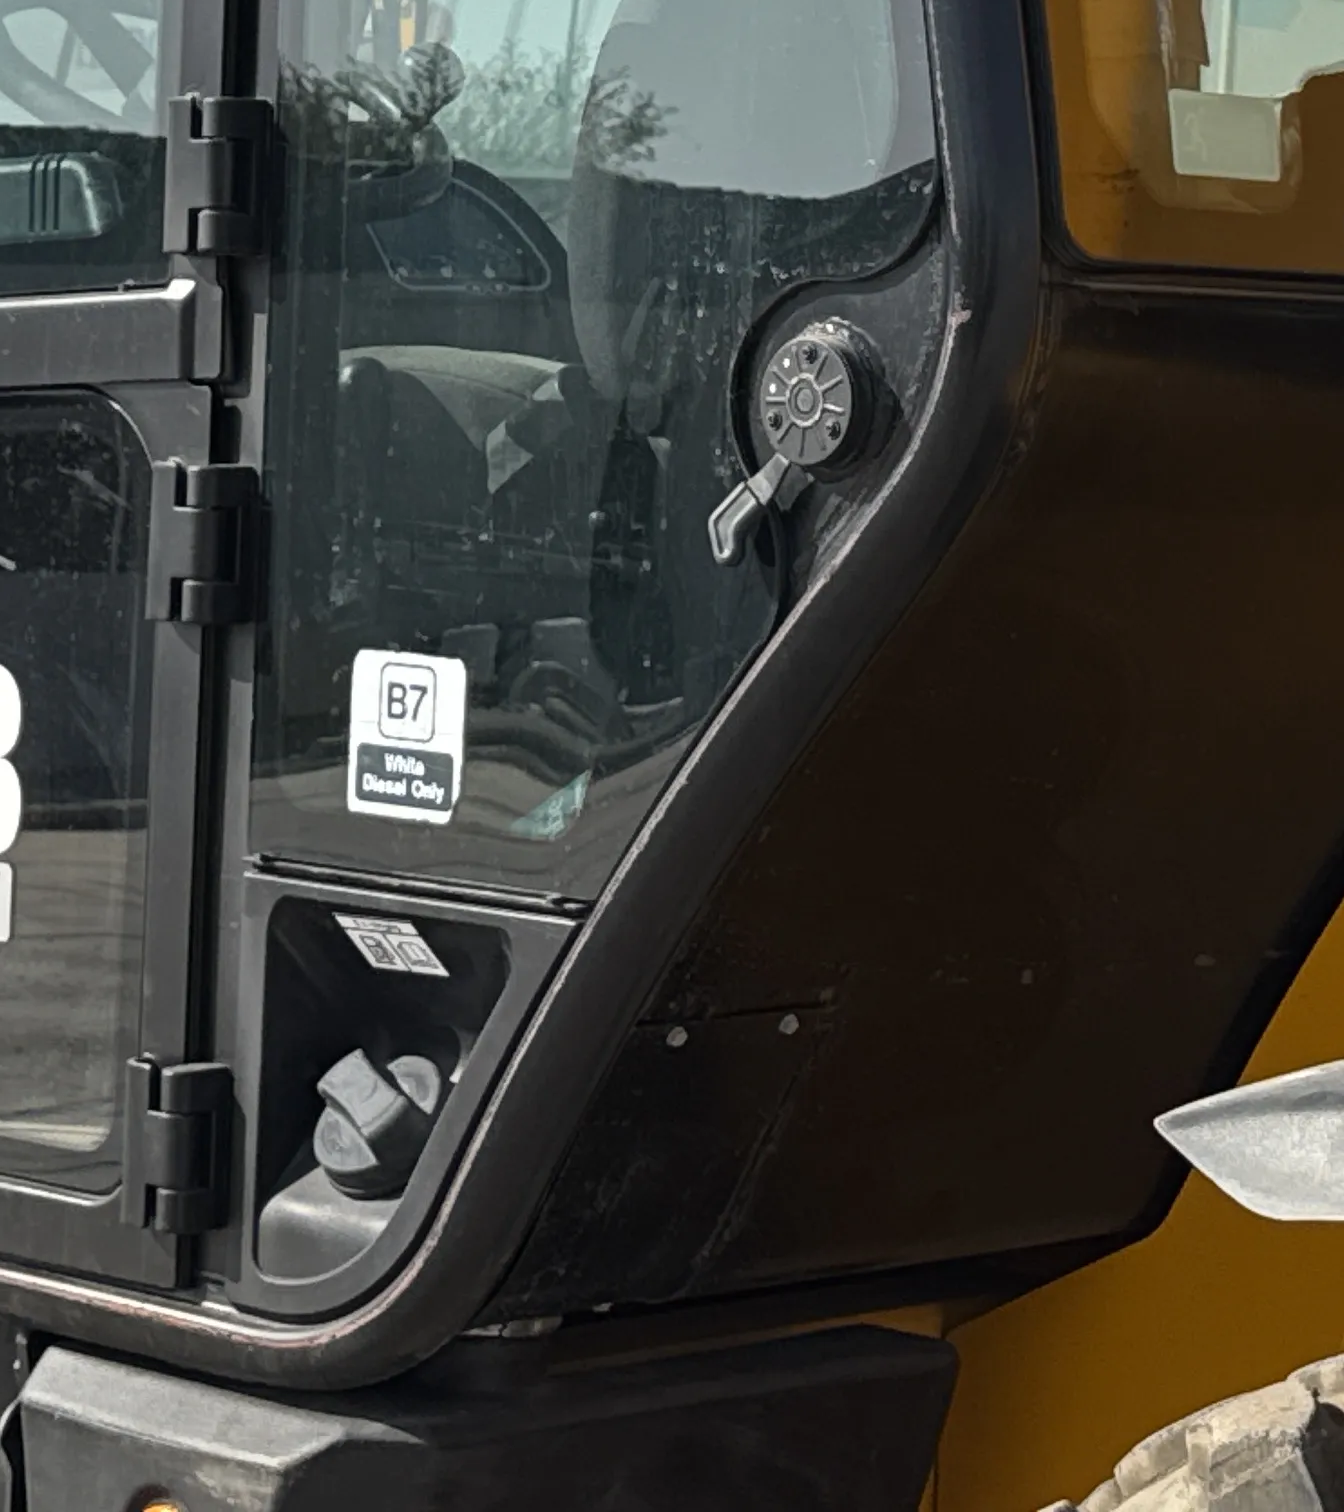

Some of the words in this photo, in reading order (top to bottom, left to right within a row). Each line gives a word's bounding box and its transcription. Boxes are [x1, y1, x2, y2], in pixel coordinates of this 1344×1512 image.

[387, 681, 428, 722] B7
[384, 752, 425, 776] White
[362, 772, 407, 797] Diesel
[410, 779, 445, 805] Only
